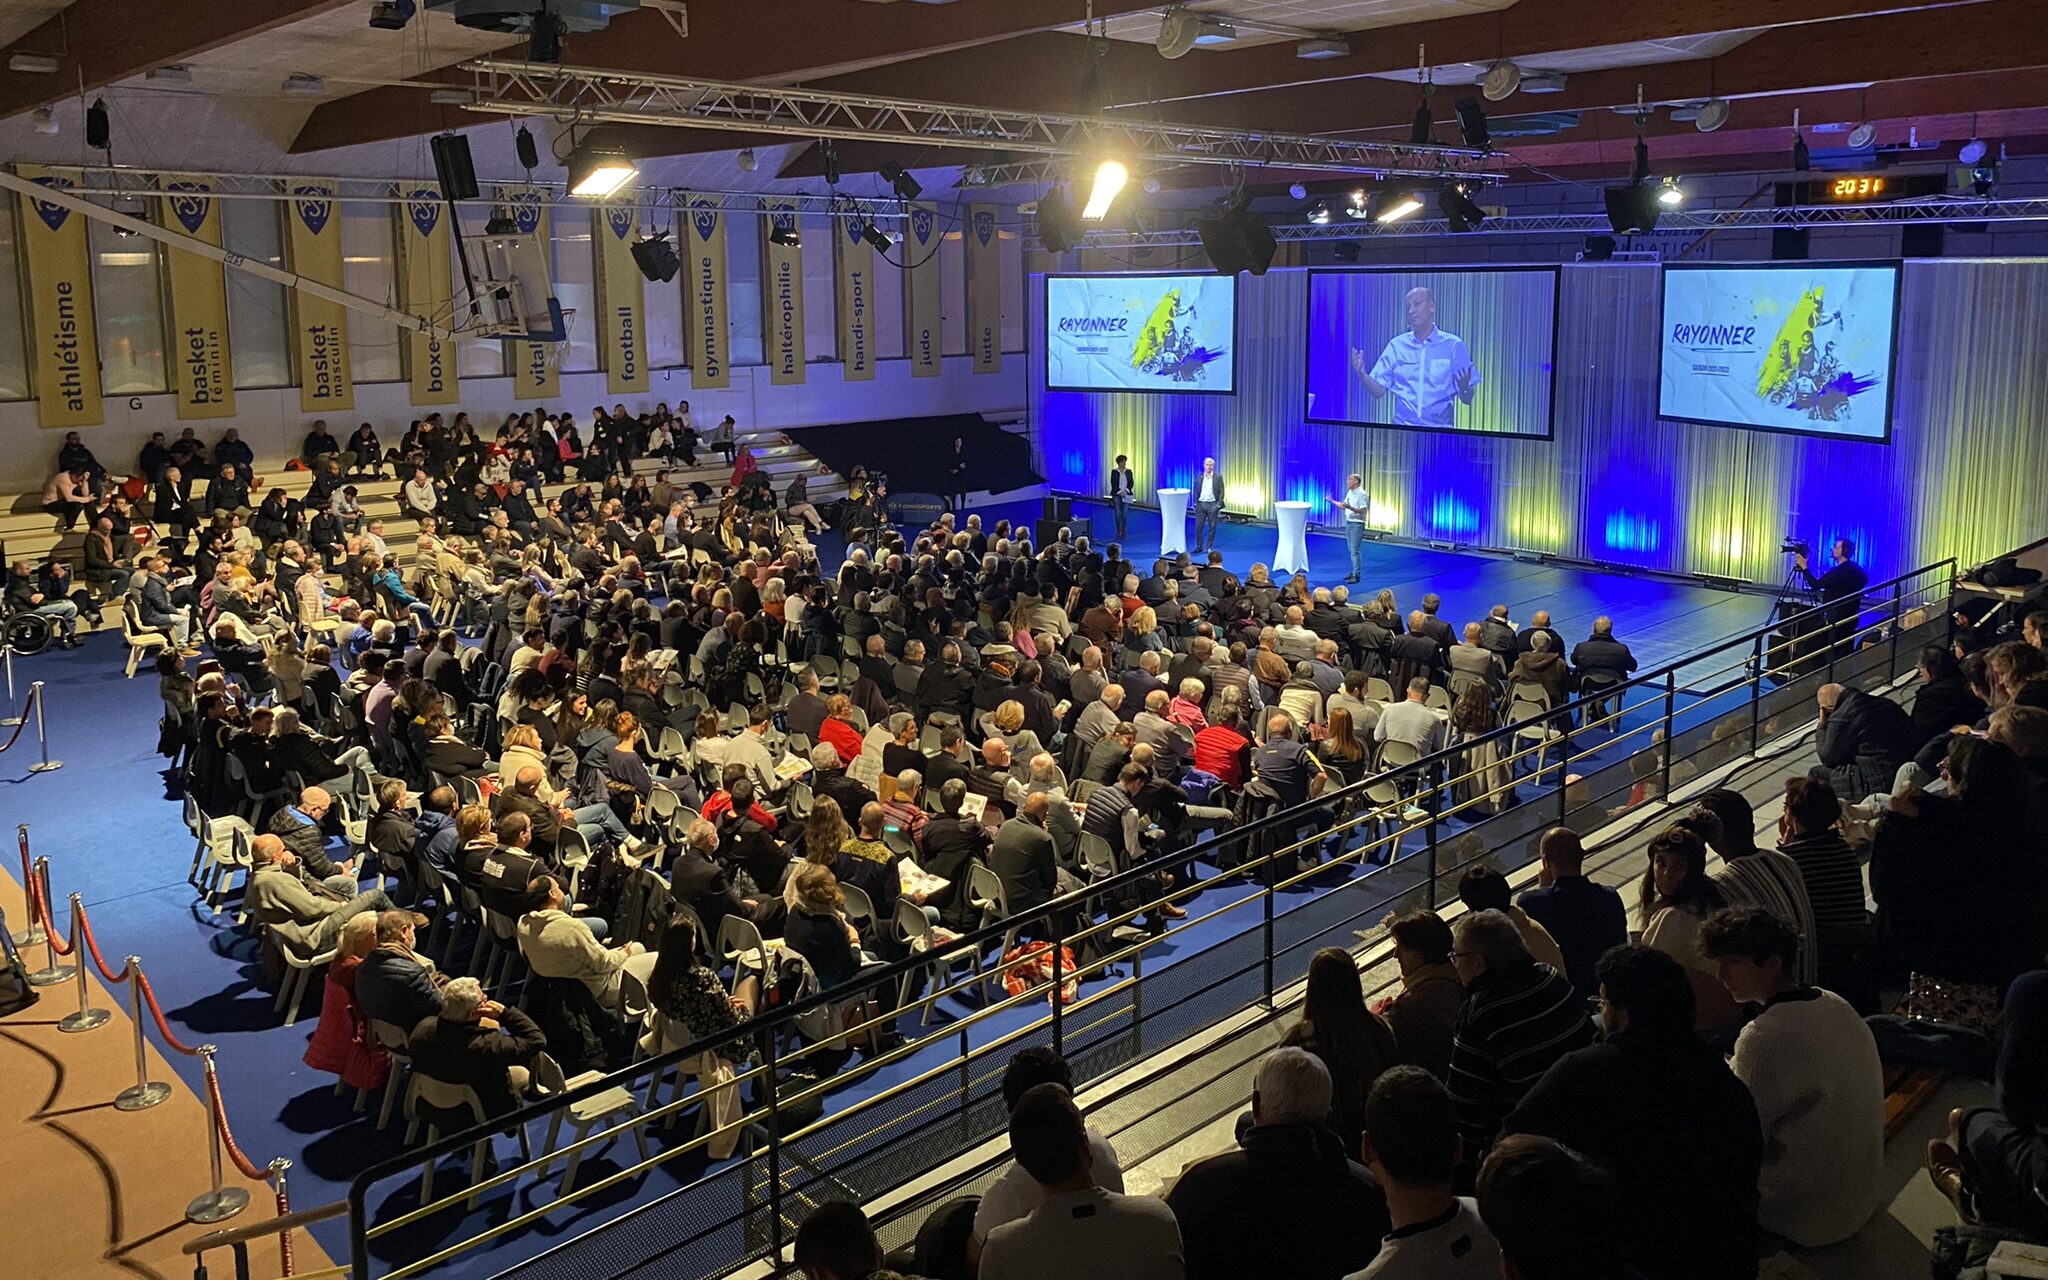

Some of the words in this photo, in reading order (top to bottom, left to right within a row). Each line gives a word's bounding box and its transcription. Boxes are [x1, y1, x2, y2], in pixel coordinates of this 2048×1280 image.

[54, 281, 84, 411] athlétisme
[618, 306, 635, 382] football
[700, 257, 719, 378] gymnastique
[778, 261, 794, 374] haltérophilie
[851, 271, 864, 371] handi-sport
[920, 329, 933, 366] judo
[982, 327, 992, 364] lutte
[1058, 317, 1128, 332] RAYONNER
[1671, 323, 1756, 346] RAYONNER
[185, 327, 209, 404] basket
[206, 330, 223, 403] féminin
[308, 324, 331, 398] basket
[327, 326, 343, 397] masculin
[427, 341, 443, 392] boxe
[129, 397, 143, 410] G
